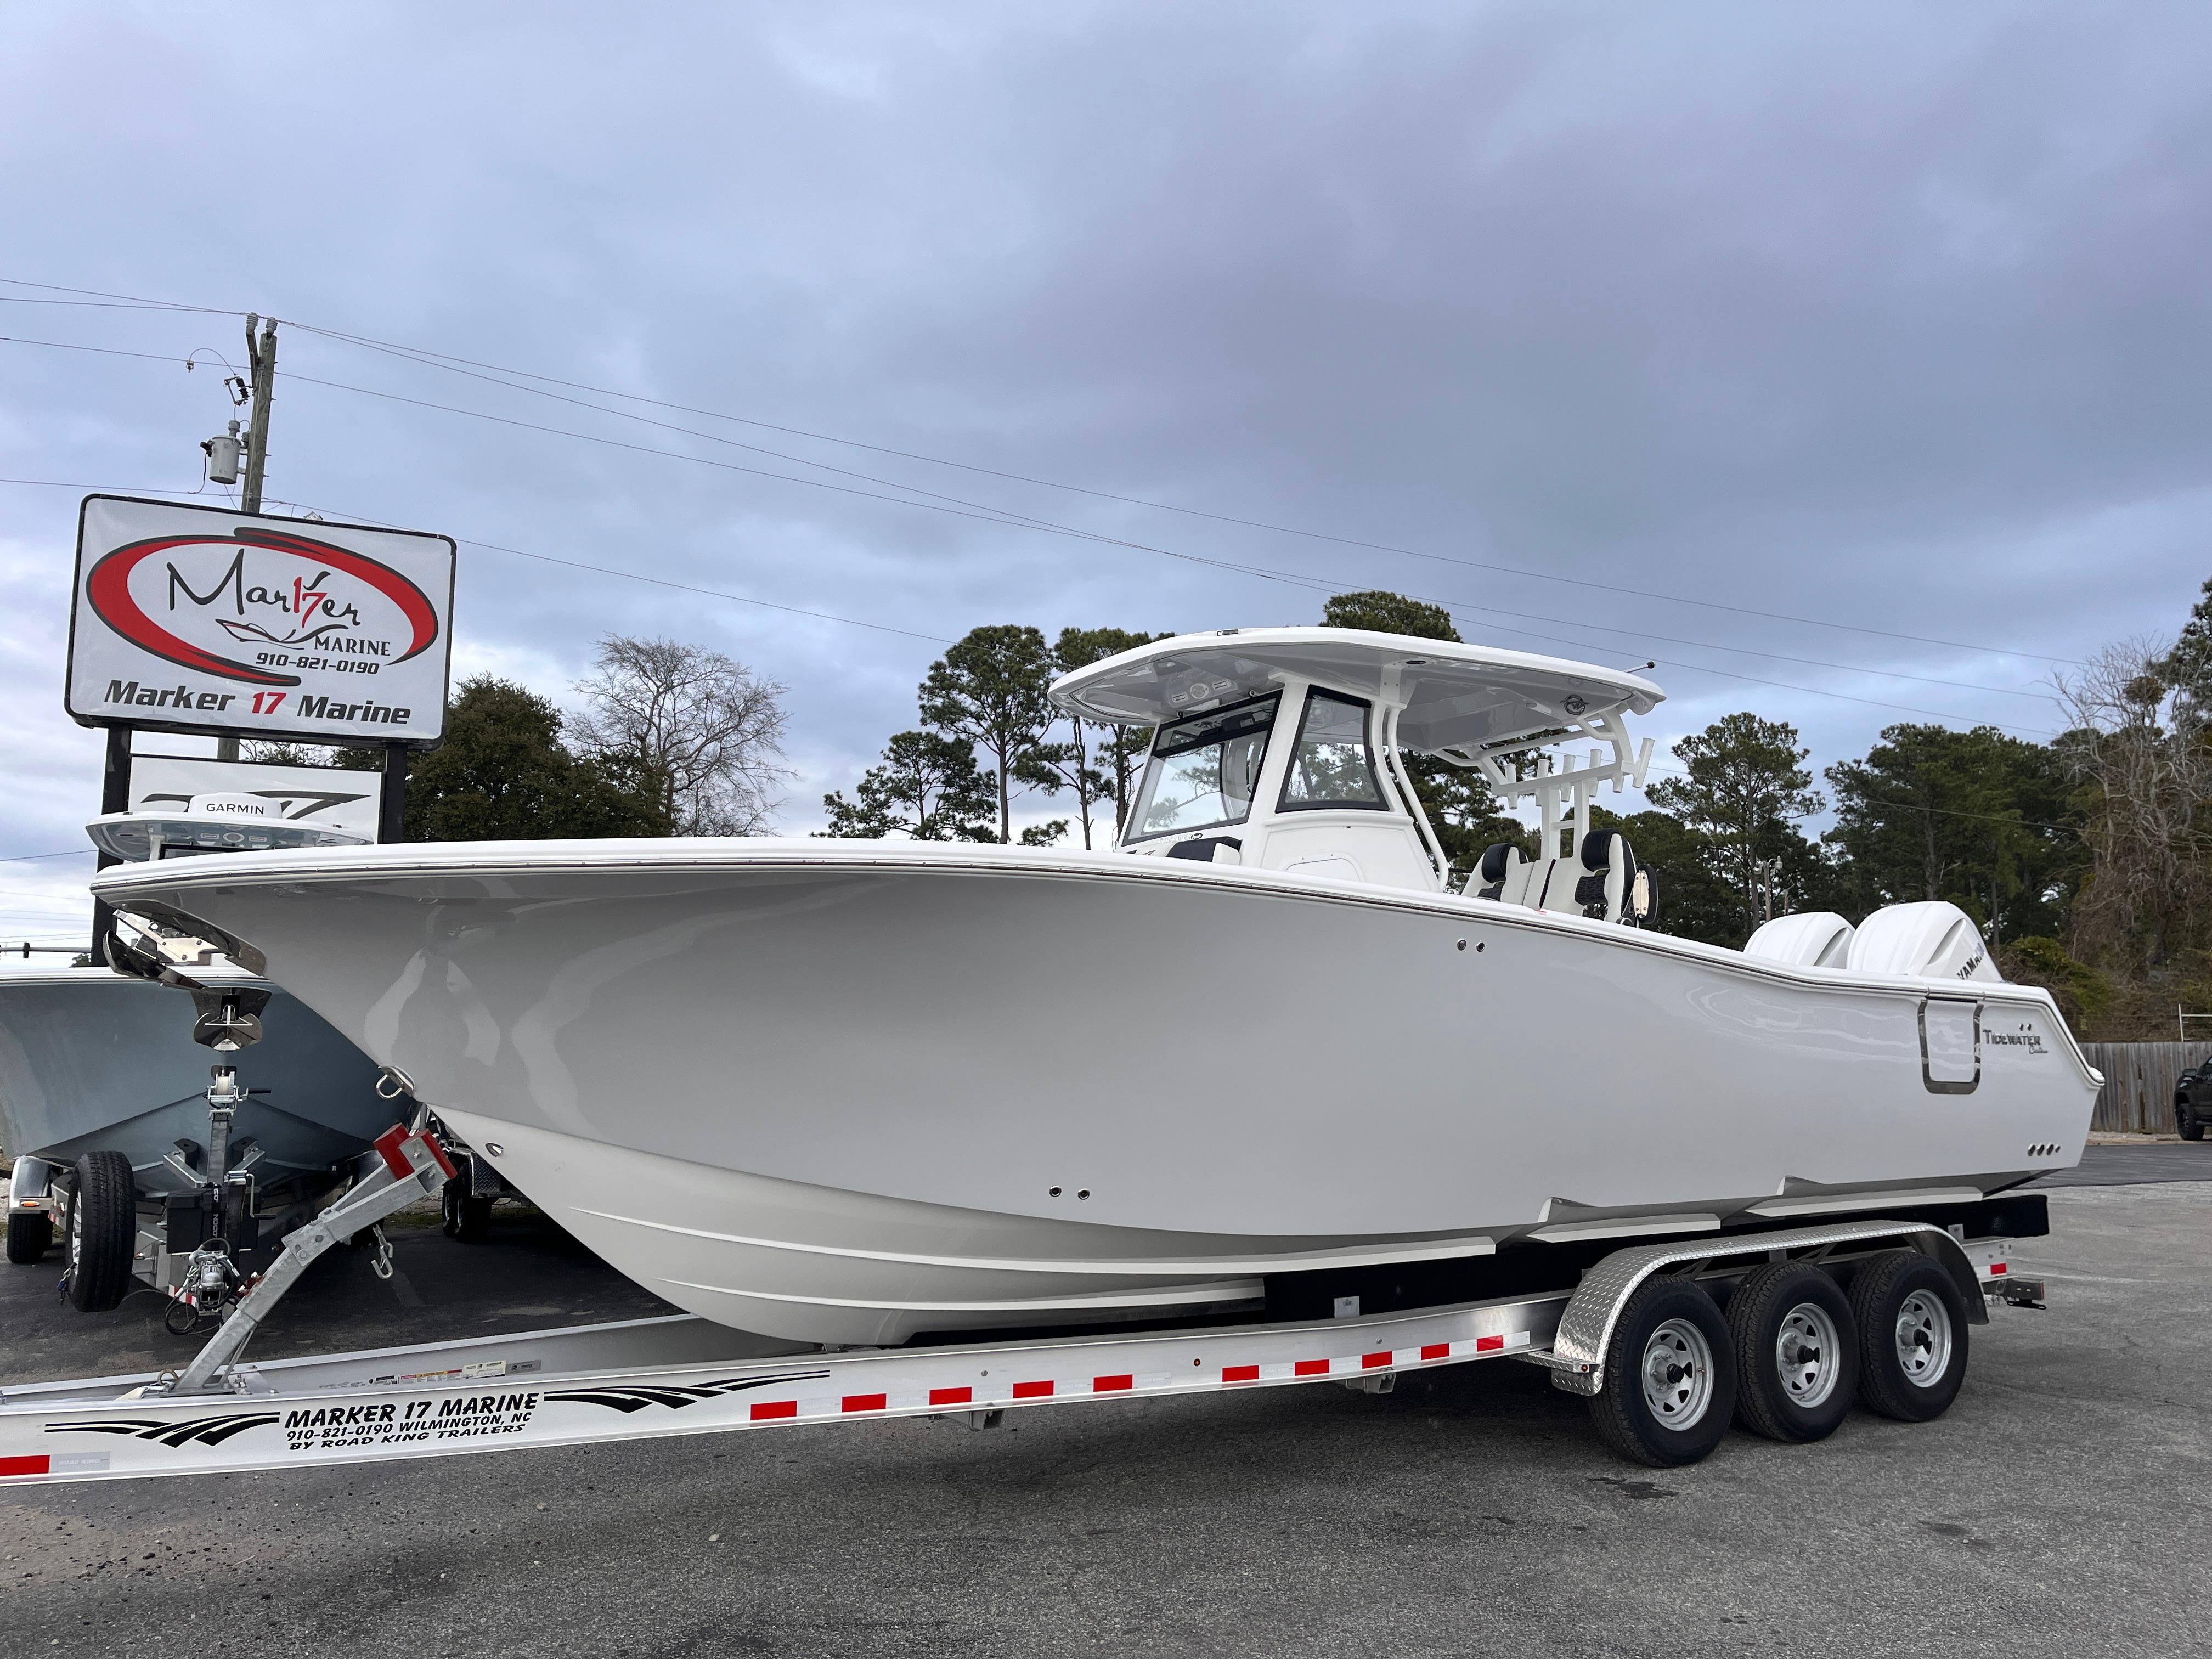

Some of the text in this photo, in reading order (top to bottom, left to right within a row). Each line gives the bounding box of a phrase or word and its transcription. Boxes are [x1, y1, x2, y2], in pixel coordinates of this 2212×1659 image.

[314, 635, 391, 657] MARINE
[255, 652, 380, 675] 910-821-0190
[104, 679, 411, 725] Marker 17 Marine
[206, 803, 264, 815] GARMIN
[284, 1392, 540, 1429] MARKER 17 MARINE
[286, 1412, 532, 1441] 910-821-0190 WILMINGTON, NC
[289, 1423, 526, 1451] BY ROAD KING TRAILERS
